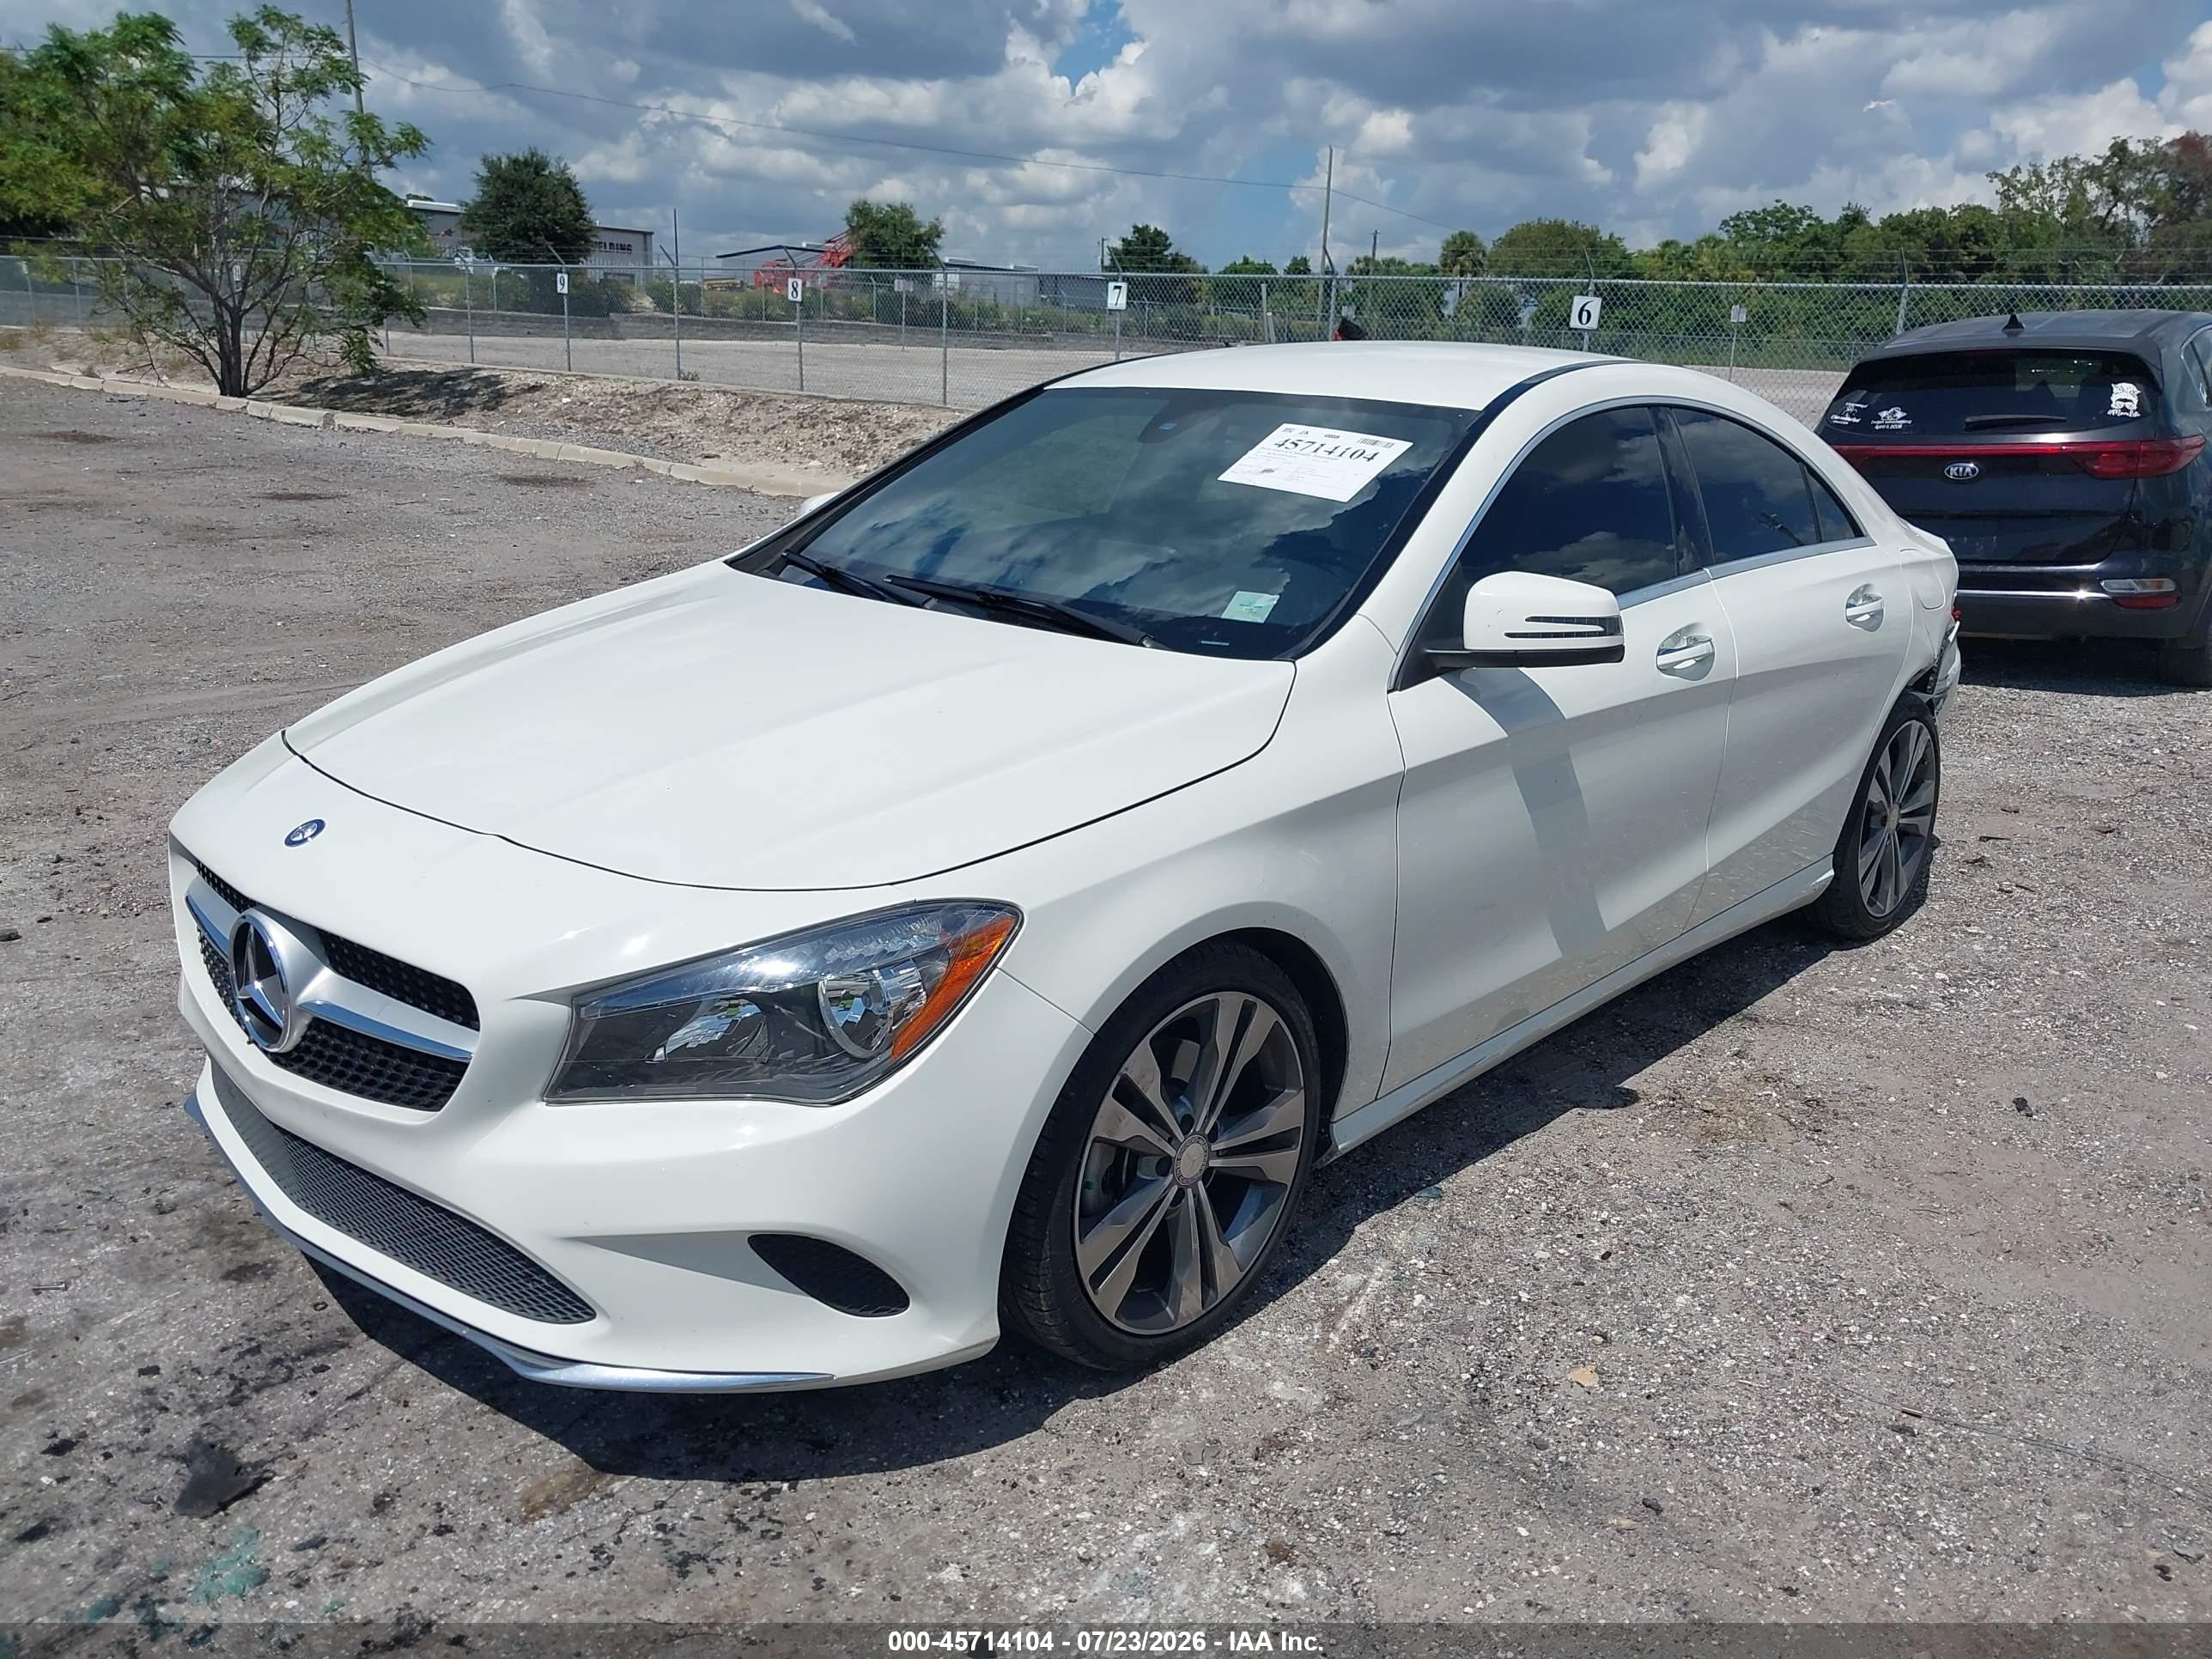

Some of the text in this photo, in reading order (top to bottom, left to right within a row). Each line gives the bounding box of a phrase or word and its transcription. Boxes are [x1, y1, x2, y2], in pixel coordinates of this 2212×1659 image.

[594, 241, 633, 254] ELDING
[559, 275, 565, 291] 9
[791, 280, 799, 299] 8
[1113, 285, 1122, 307] 7
[1577, 300, 1595, 325] 6
[1274, 438, 1380, 462] 45714104
[1949, 466, 1972, 477] KIA
